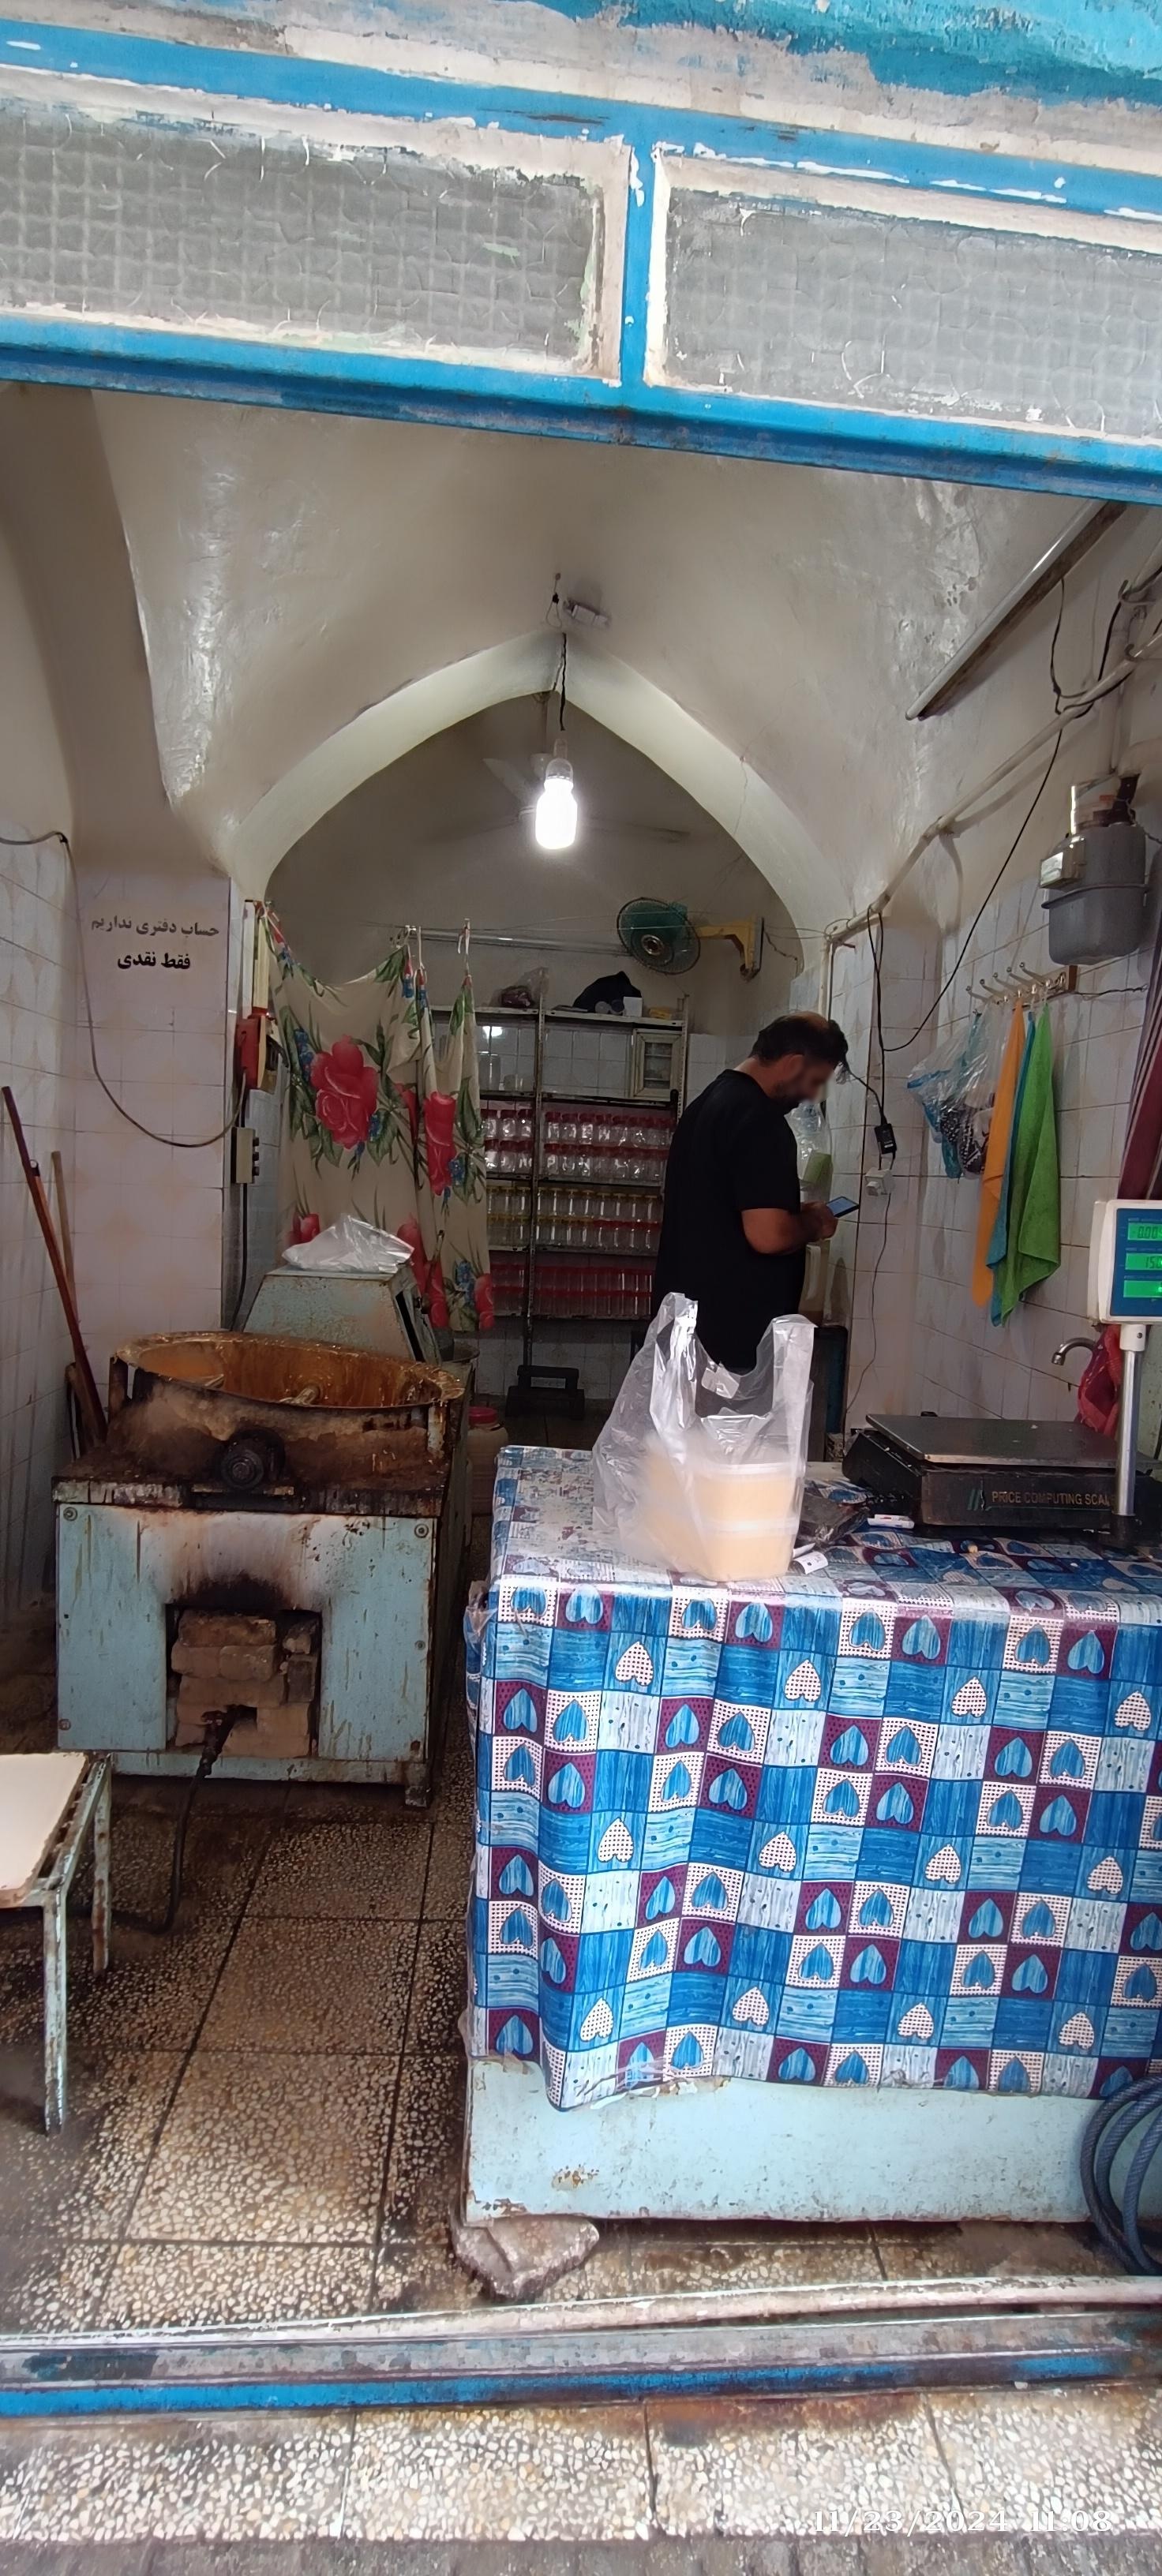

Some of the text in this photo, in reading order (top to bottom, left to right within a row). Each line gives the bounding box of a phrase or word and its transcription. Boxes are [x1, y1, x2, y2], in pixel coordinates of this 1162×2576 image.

[91, 915, 219, 938] حساب دفتری نداریم
[118, 951, 191, 969] فقط نقدی
[991, 1491, 1113, 1507] PRICE COMPUTING SCAL
